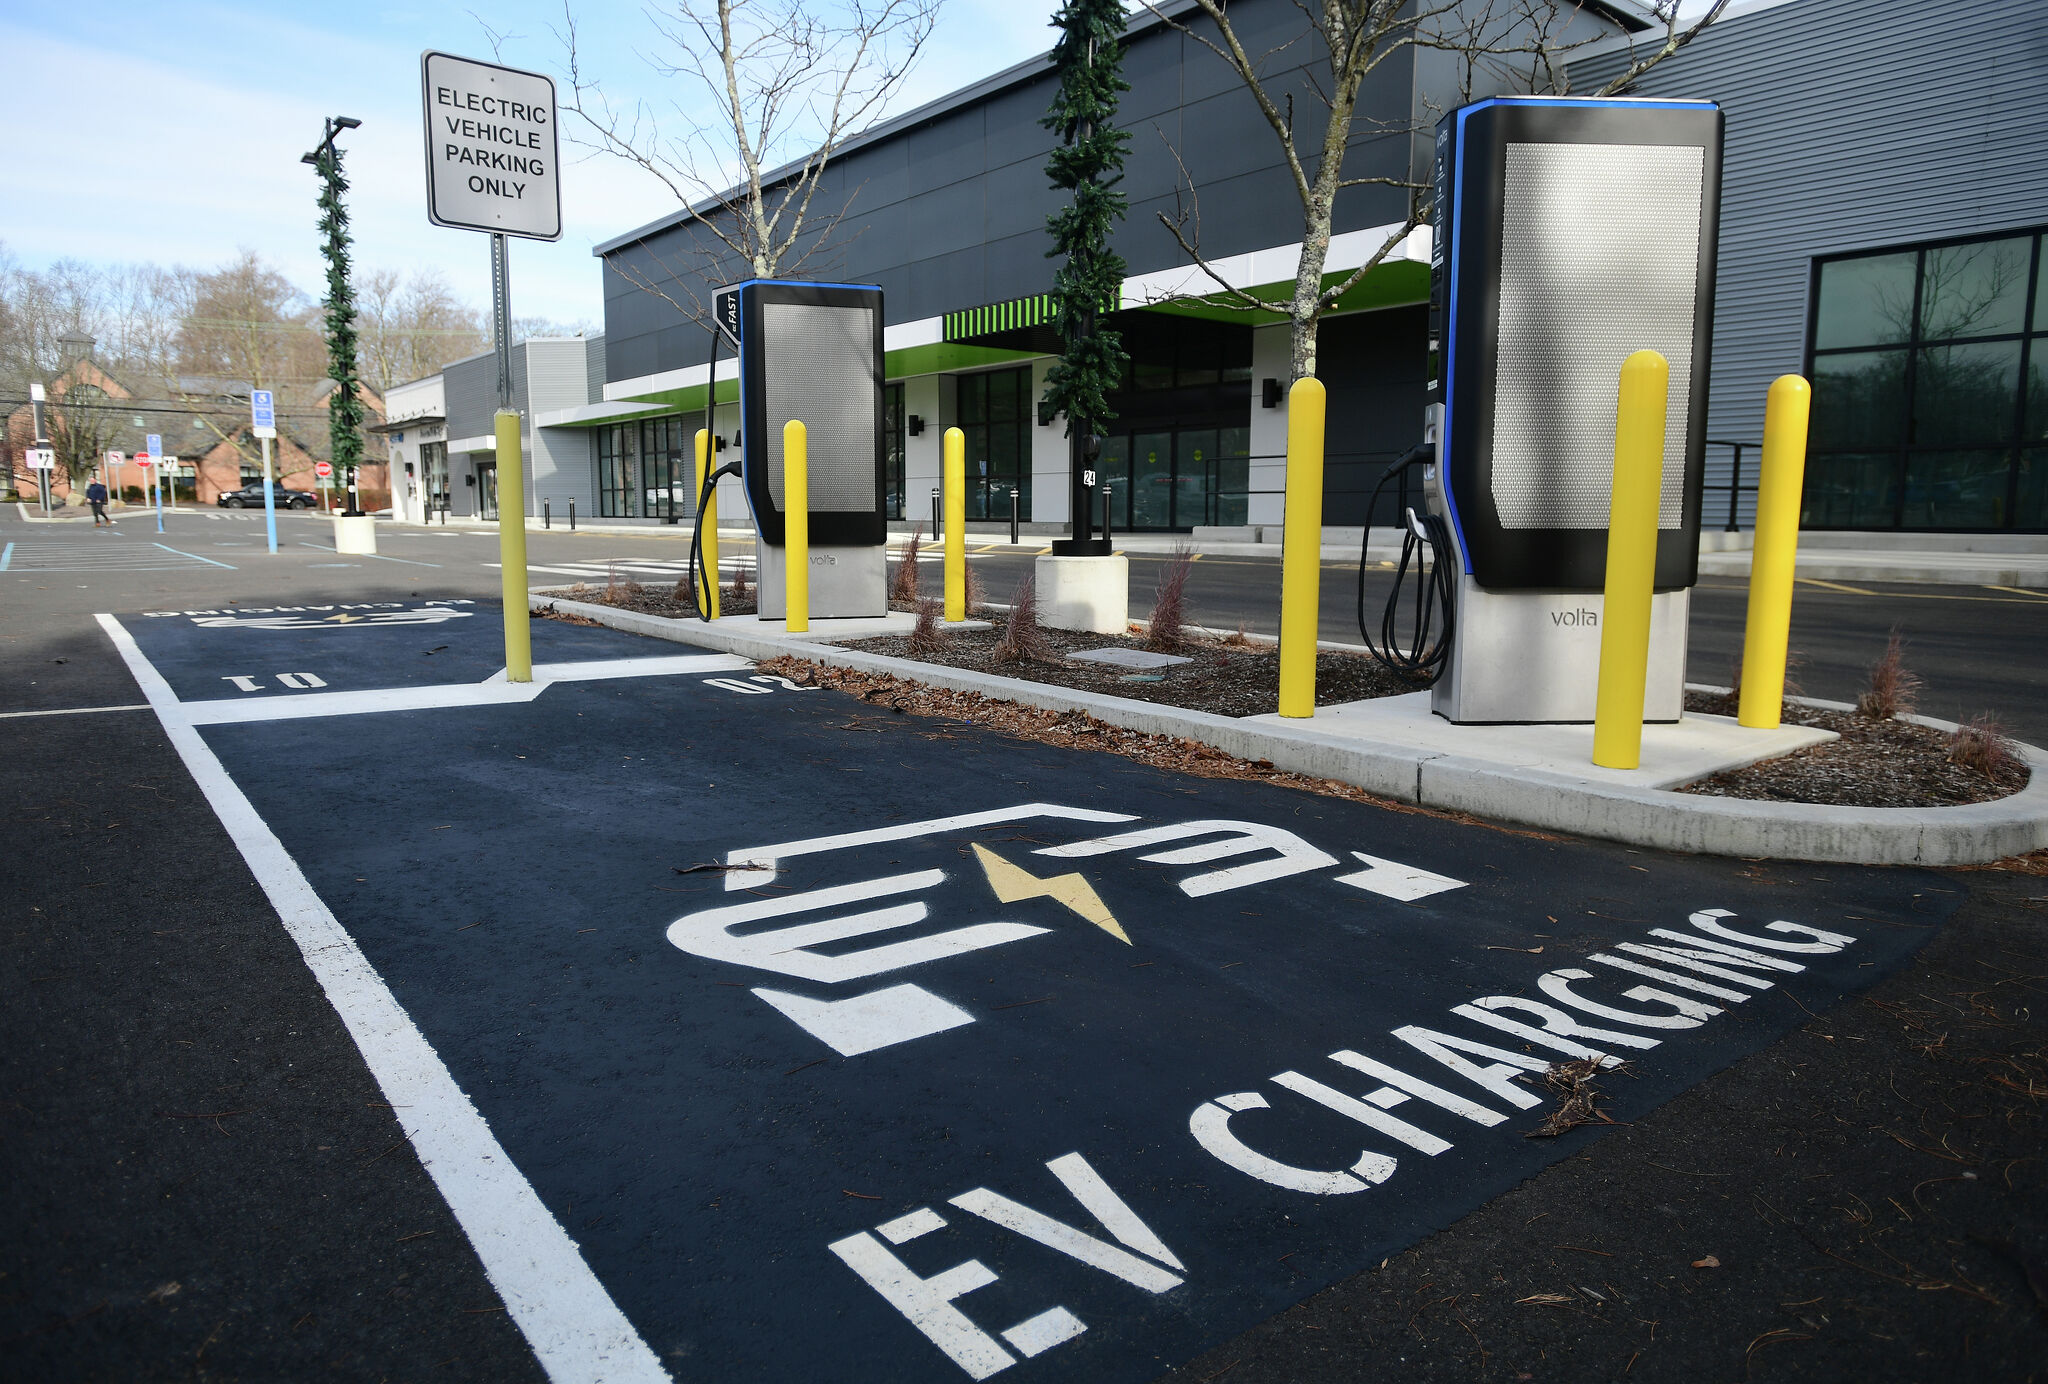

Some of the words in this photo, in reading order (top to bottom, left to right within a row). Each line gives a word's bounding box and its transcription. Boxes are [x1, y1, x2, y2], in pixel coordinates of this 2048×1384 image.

[437, 86, 547, 124] ELECTRIC
[445, 116, 541, 150] VEHICLE
[446, 143, 544, 176] PARKING
[468, 175, 526, 200] ONLY
[727, 294, 737, 324] FAST
[1084, 471, 1095, 485] 24
[809, 554, 837, 566] volta
[1551, 608, 1598, 627] volta
[221, 672, 329, 692] 01
[702, 675, 825, 694] 02
[827, 1151, 1188, 1383] EV
[1188, 908, 1859, 1196] CHARGING
